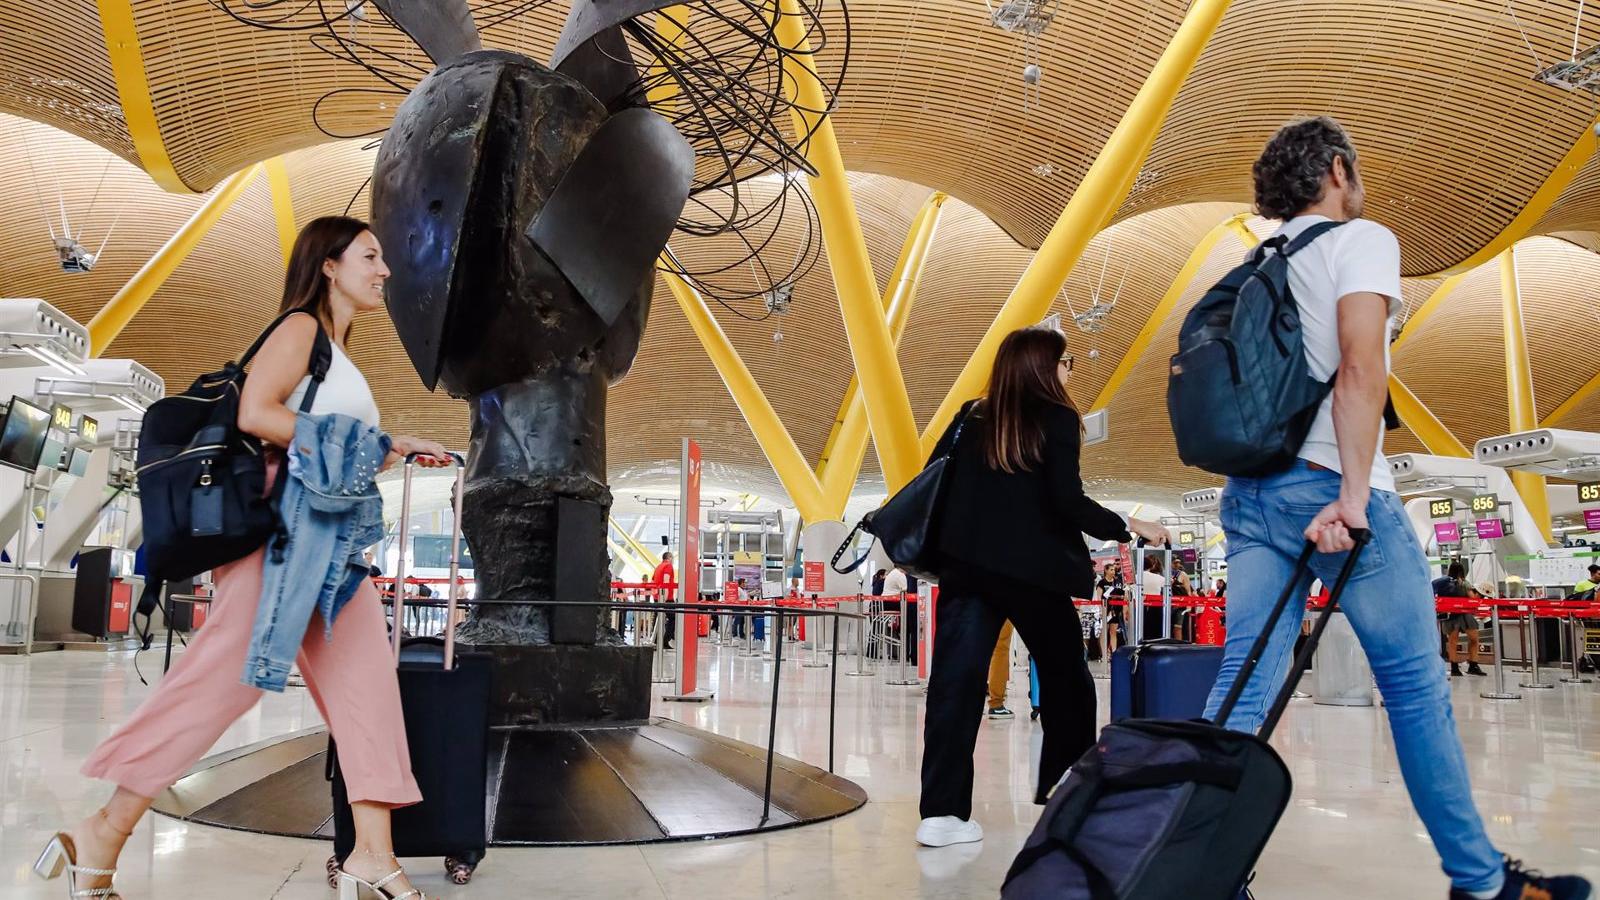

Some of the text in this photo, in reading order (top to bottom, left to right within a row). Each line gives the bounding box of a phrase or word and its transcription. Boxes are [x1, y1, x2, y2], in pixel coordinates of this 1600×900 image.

[1581, 485, 1600, 499] 85
[1432, 502, 1451, 515] 855
[1473, 497, 1494, 510] 856
[1207, 620, 1215, 644] eck-in
